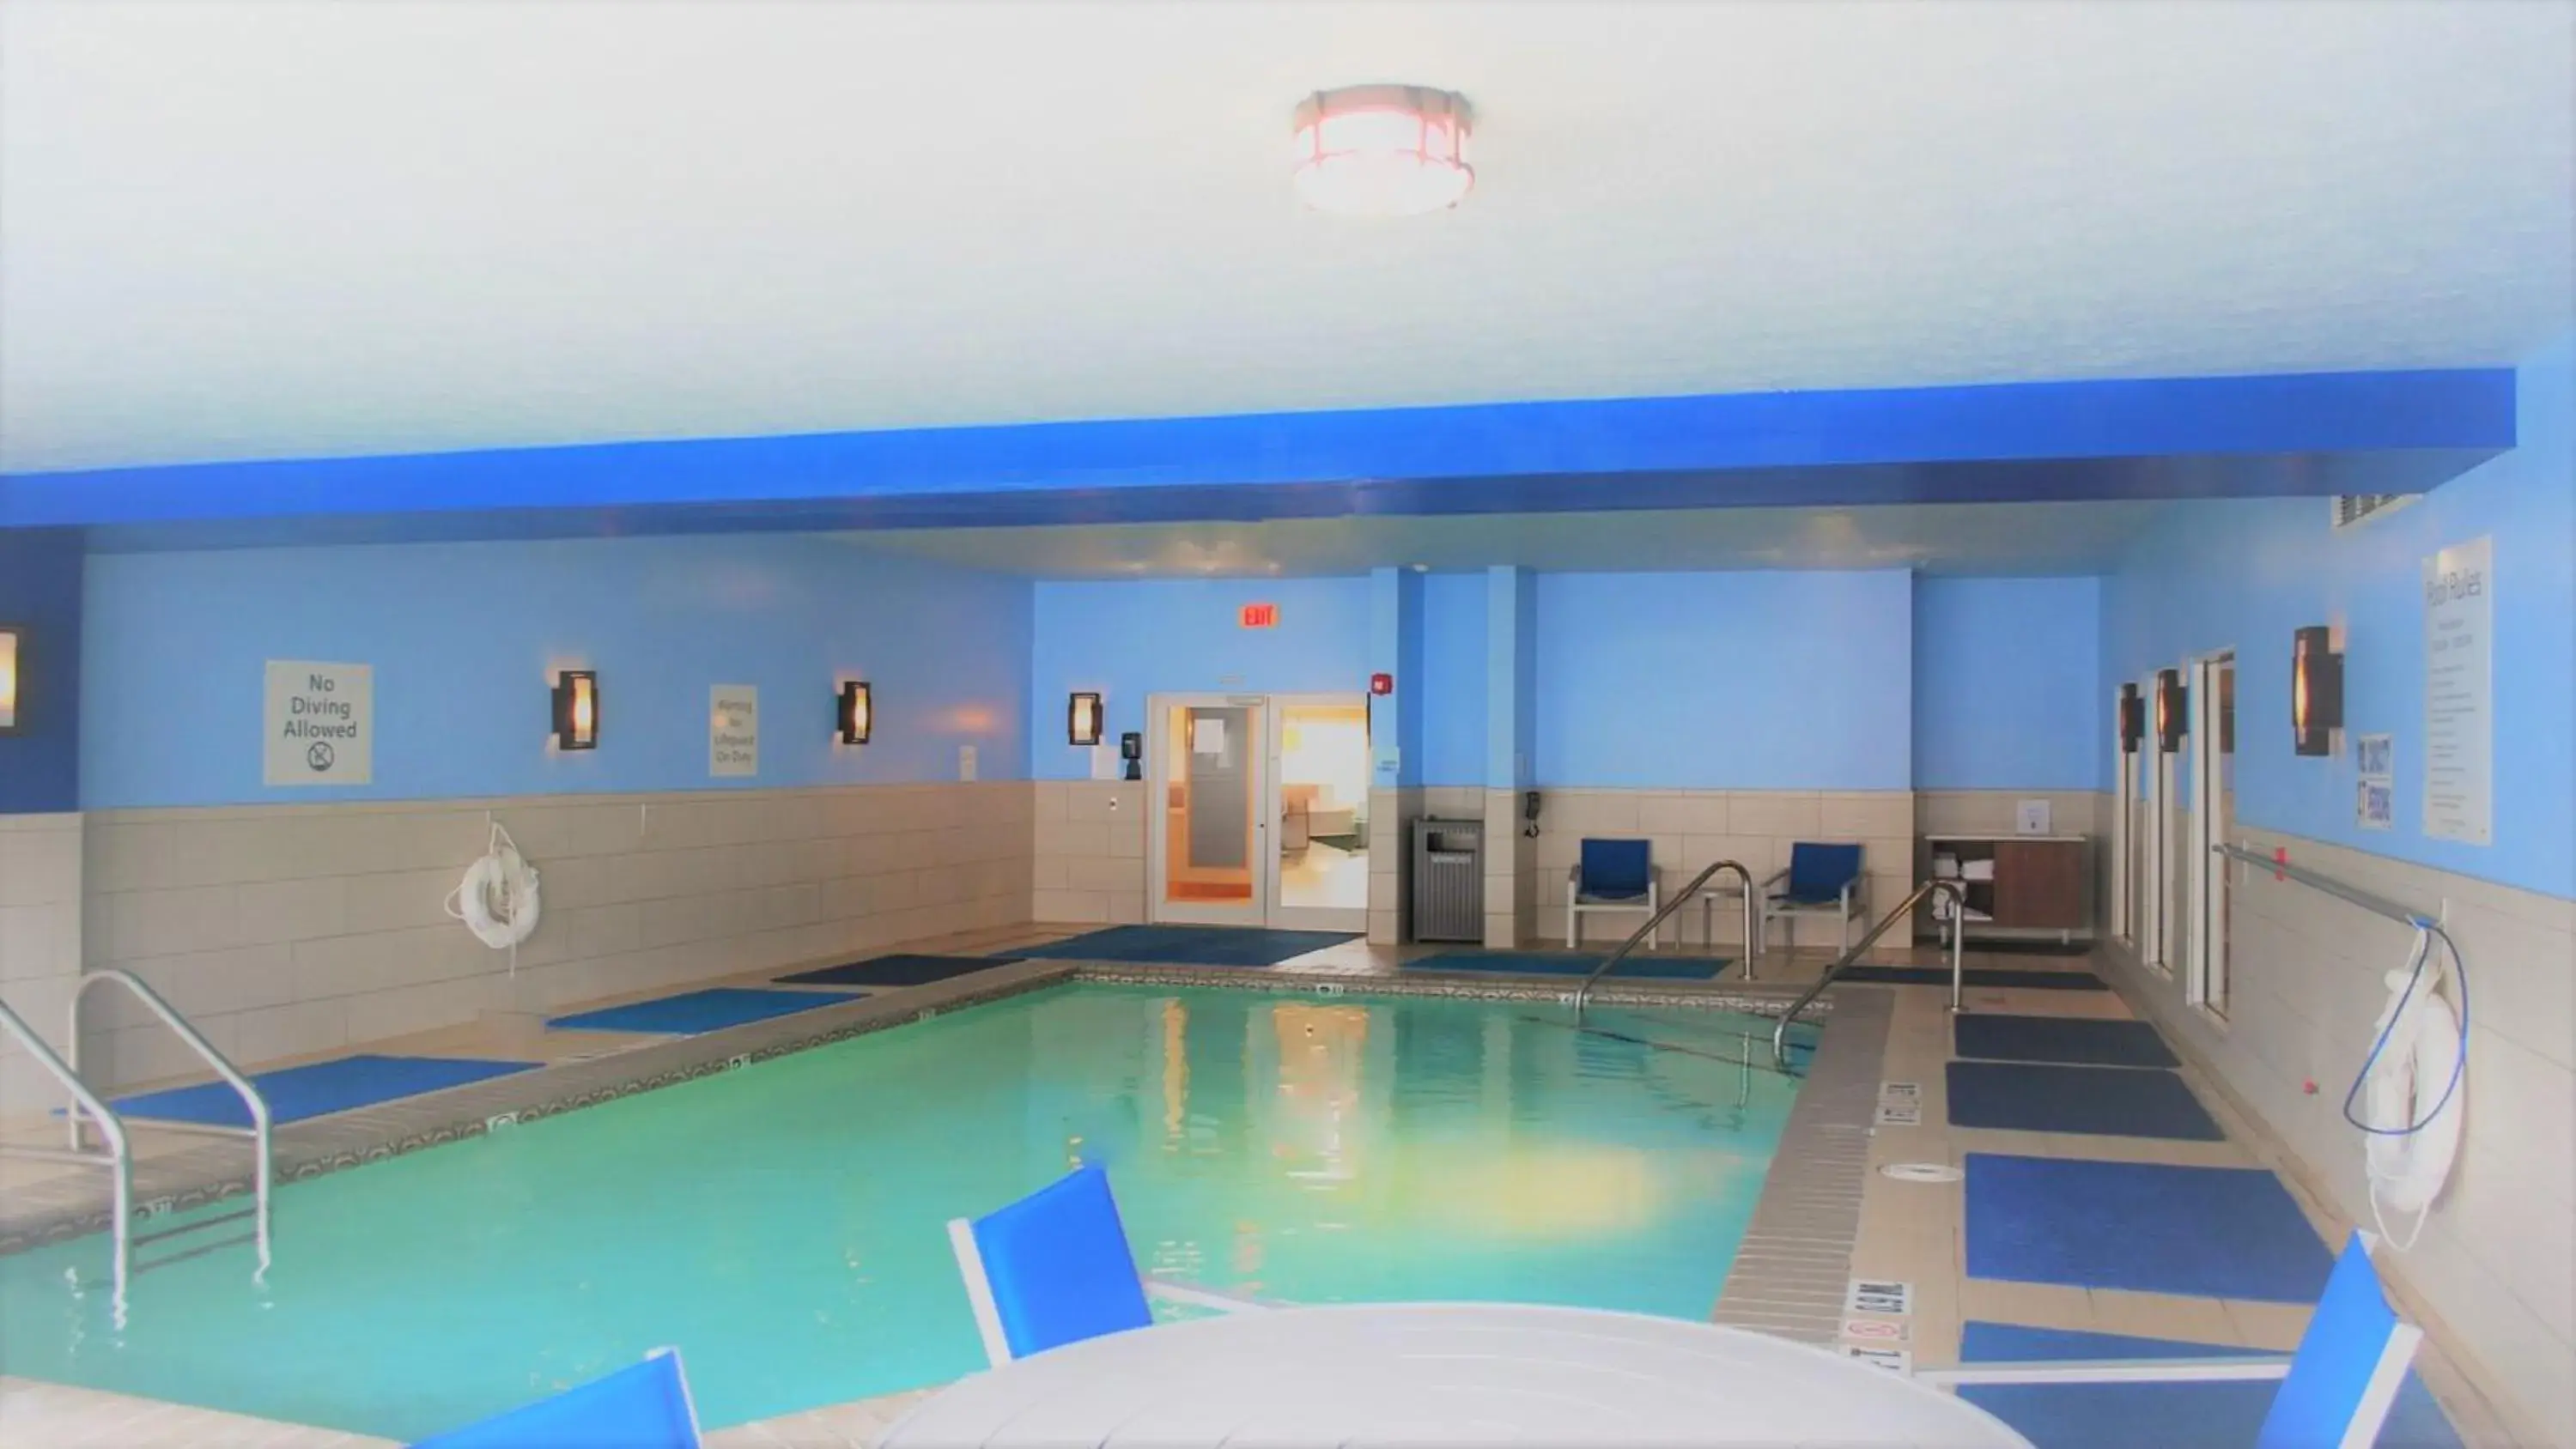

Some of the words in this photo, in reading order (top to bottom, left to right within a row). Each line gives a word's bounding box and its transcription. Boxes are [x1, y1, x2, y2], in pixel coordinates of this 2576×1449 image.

[309, 673, 335, 692] No
[291, 695, 351, 720] Diving
[283, 718, 357, 739] Allowed
